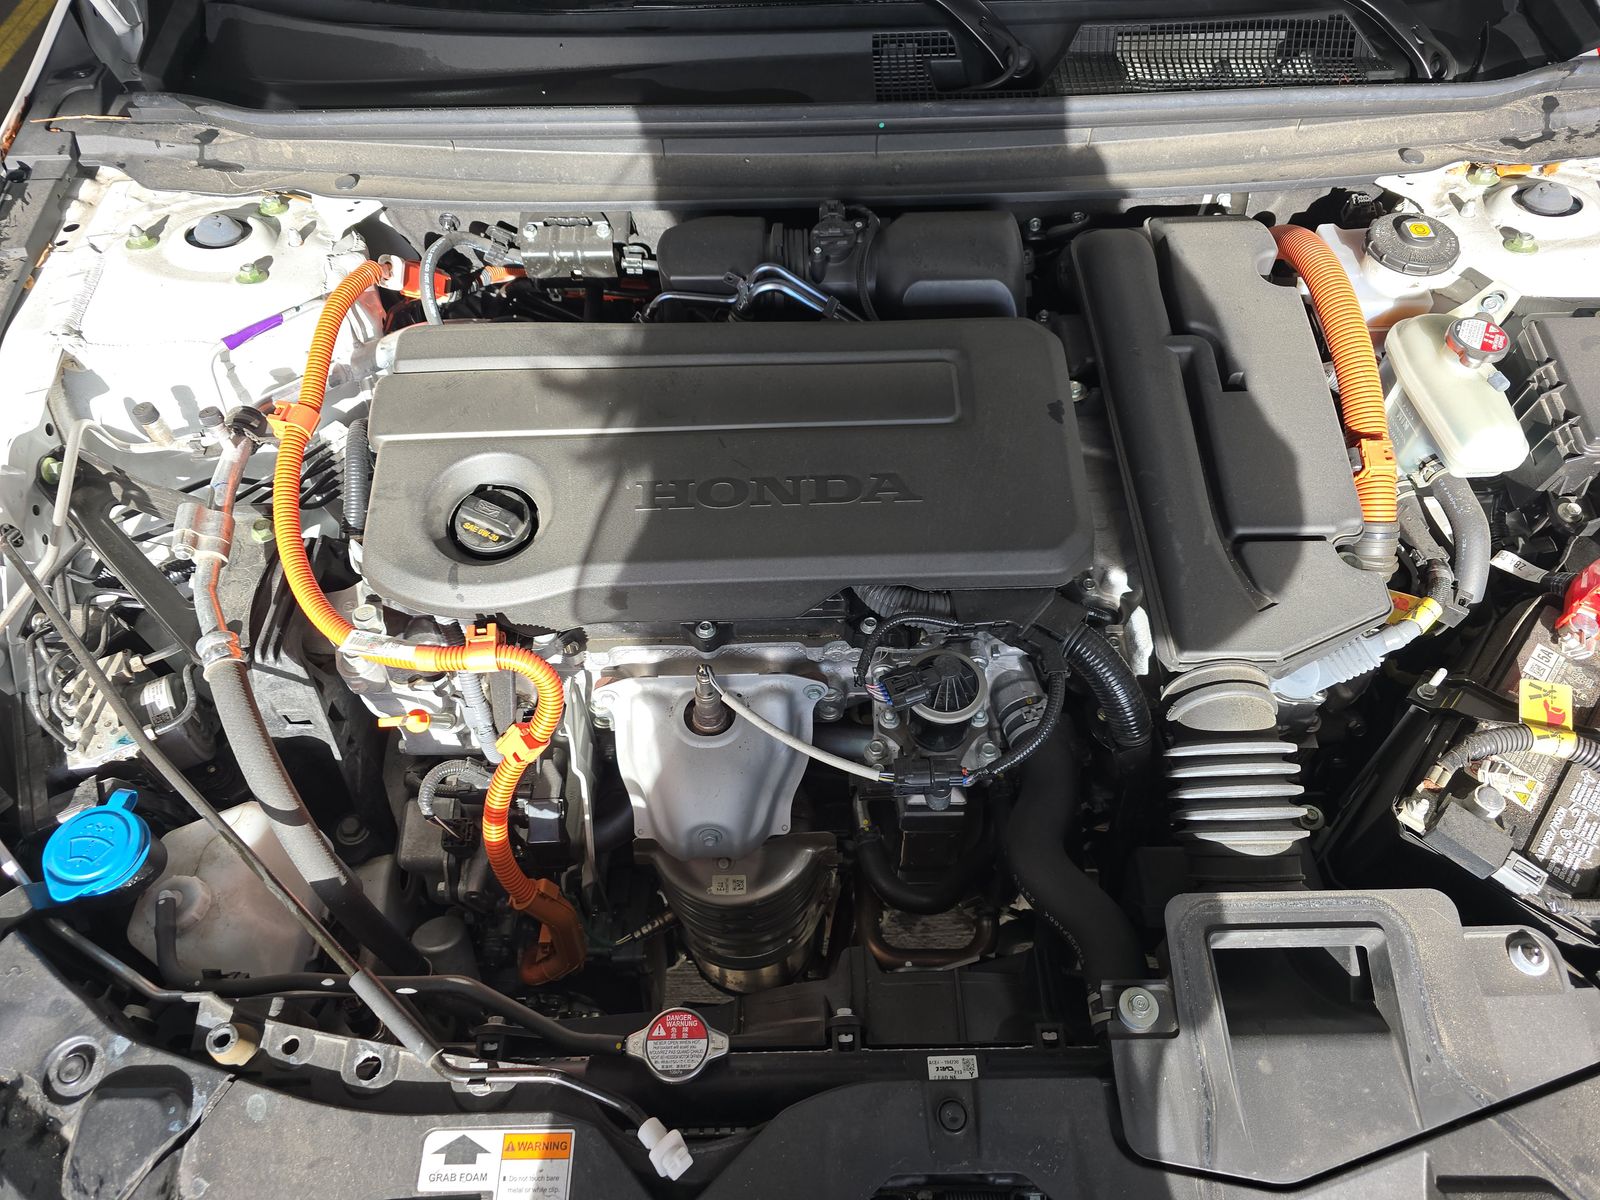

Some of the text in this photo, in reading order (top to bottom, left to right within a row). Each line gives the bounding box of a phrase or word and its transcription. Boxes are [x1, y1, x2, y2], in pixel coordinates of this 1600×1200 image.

[635, 472, 923, 511] HONDA
[462, 521, 479, 533] SAE
[1537, 648, 1554, 664] 5A
[517, 1141, 568, 1151] WARNING
[428, 1172, 488, 1182] GRAB FOAM
